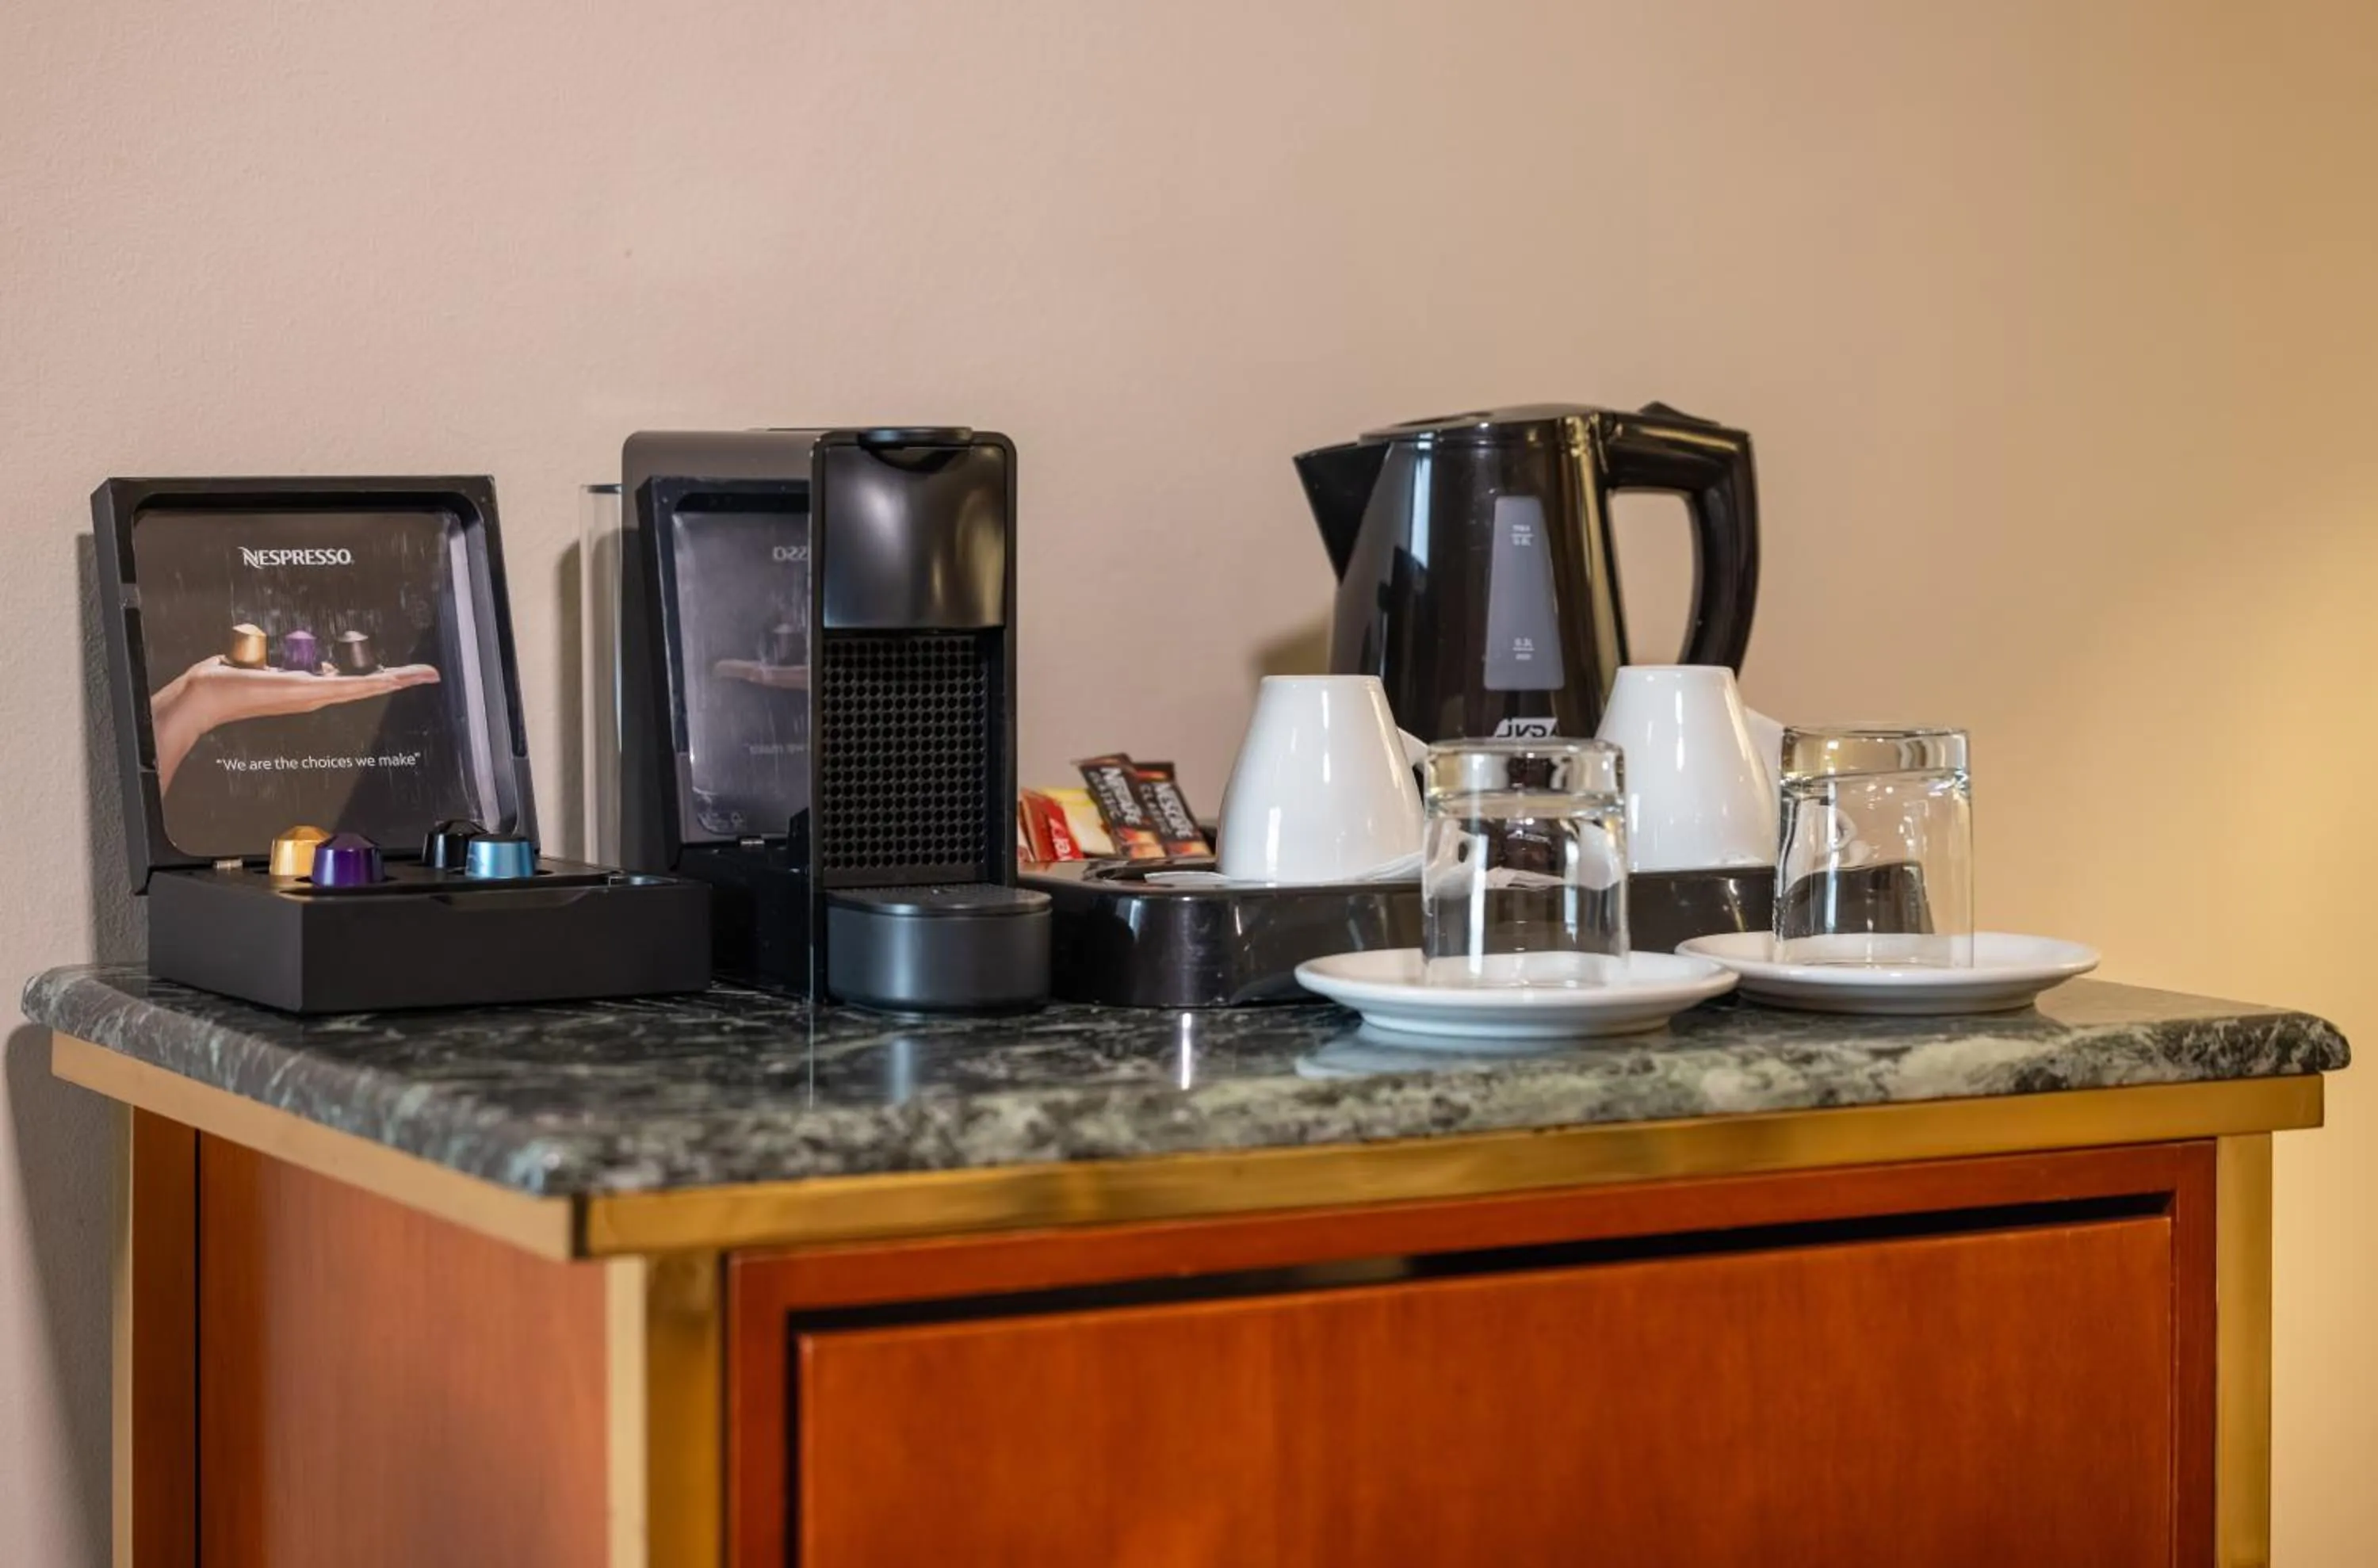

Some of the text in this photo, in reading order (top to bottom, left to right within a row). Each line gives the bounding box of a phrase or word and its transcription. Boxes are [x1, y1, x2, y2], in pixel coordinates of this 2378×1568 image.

[239, 547, 354, 569] NESPRESSO
[249, 759, 271, 771] are
[274, 755, 299, 771] the
[301, 754, 353, 769] choices
[355, 756, 376, 767] we
